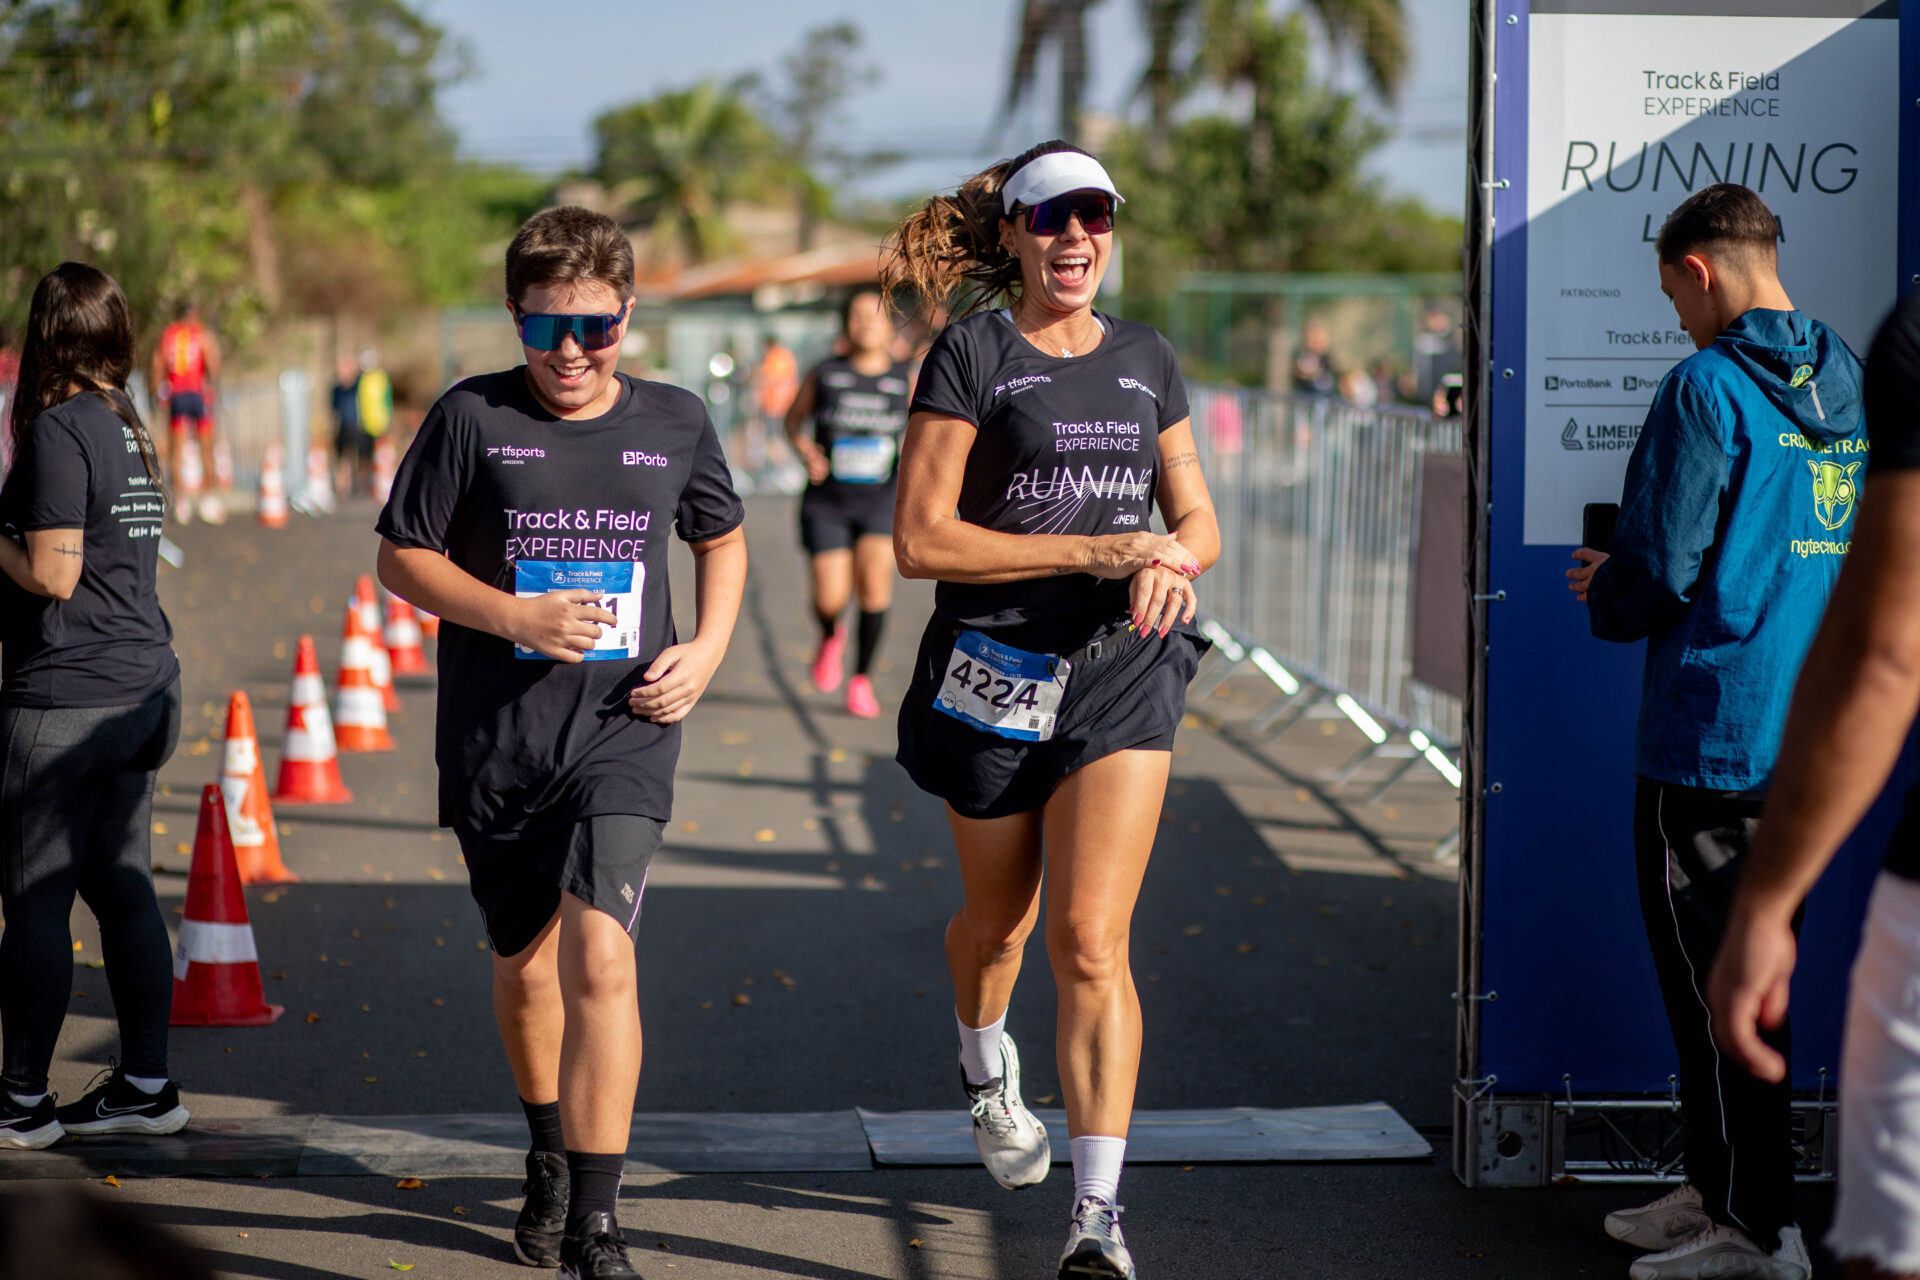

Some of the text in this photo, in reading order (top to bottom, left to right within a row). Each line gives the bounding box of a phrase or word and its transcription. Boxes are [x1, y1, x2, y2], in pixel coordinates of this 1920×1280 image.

[1643, 70, 1779, 91] Track & Field
[1644, 97, 1779, 117] EXPERIENCE
[1561, 140, 1859, 194] RUNNING
[1560, 288, 1621, 298] PATROCÍNIO
[1606, 330, 1650, 345] Track
[1651, 331, 1662, 345] &
[1007, 375, 1052, 389] tfsports
[1560, 378, 1612, 389] PortoBank
[1638, 378, 1660, 389] Port
[1053, 421, 1140, 435] Track & Field
[1586, 425, 1642, 439] LIMEIR
[501, 445, 546, 459] tfsports
[1055, 438, 1140, 452] EXPERIENCE
[1587, 440, 1635, 451] SHOPP
[636, 451, 668, 467] Porto
[1006, 465, 1152, 501] RUNNING
[504, 508, 651, 532] Track & Field
[505, 536, 646, 560] EXPERIENCE
[951, 659, 1039, 711] 4224
